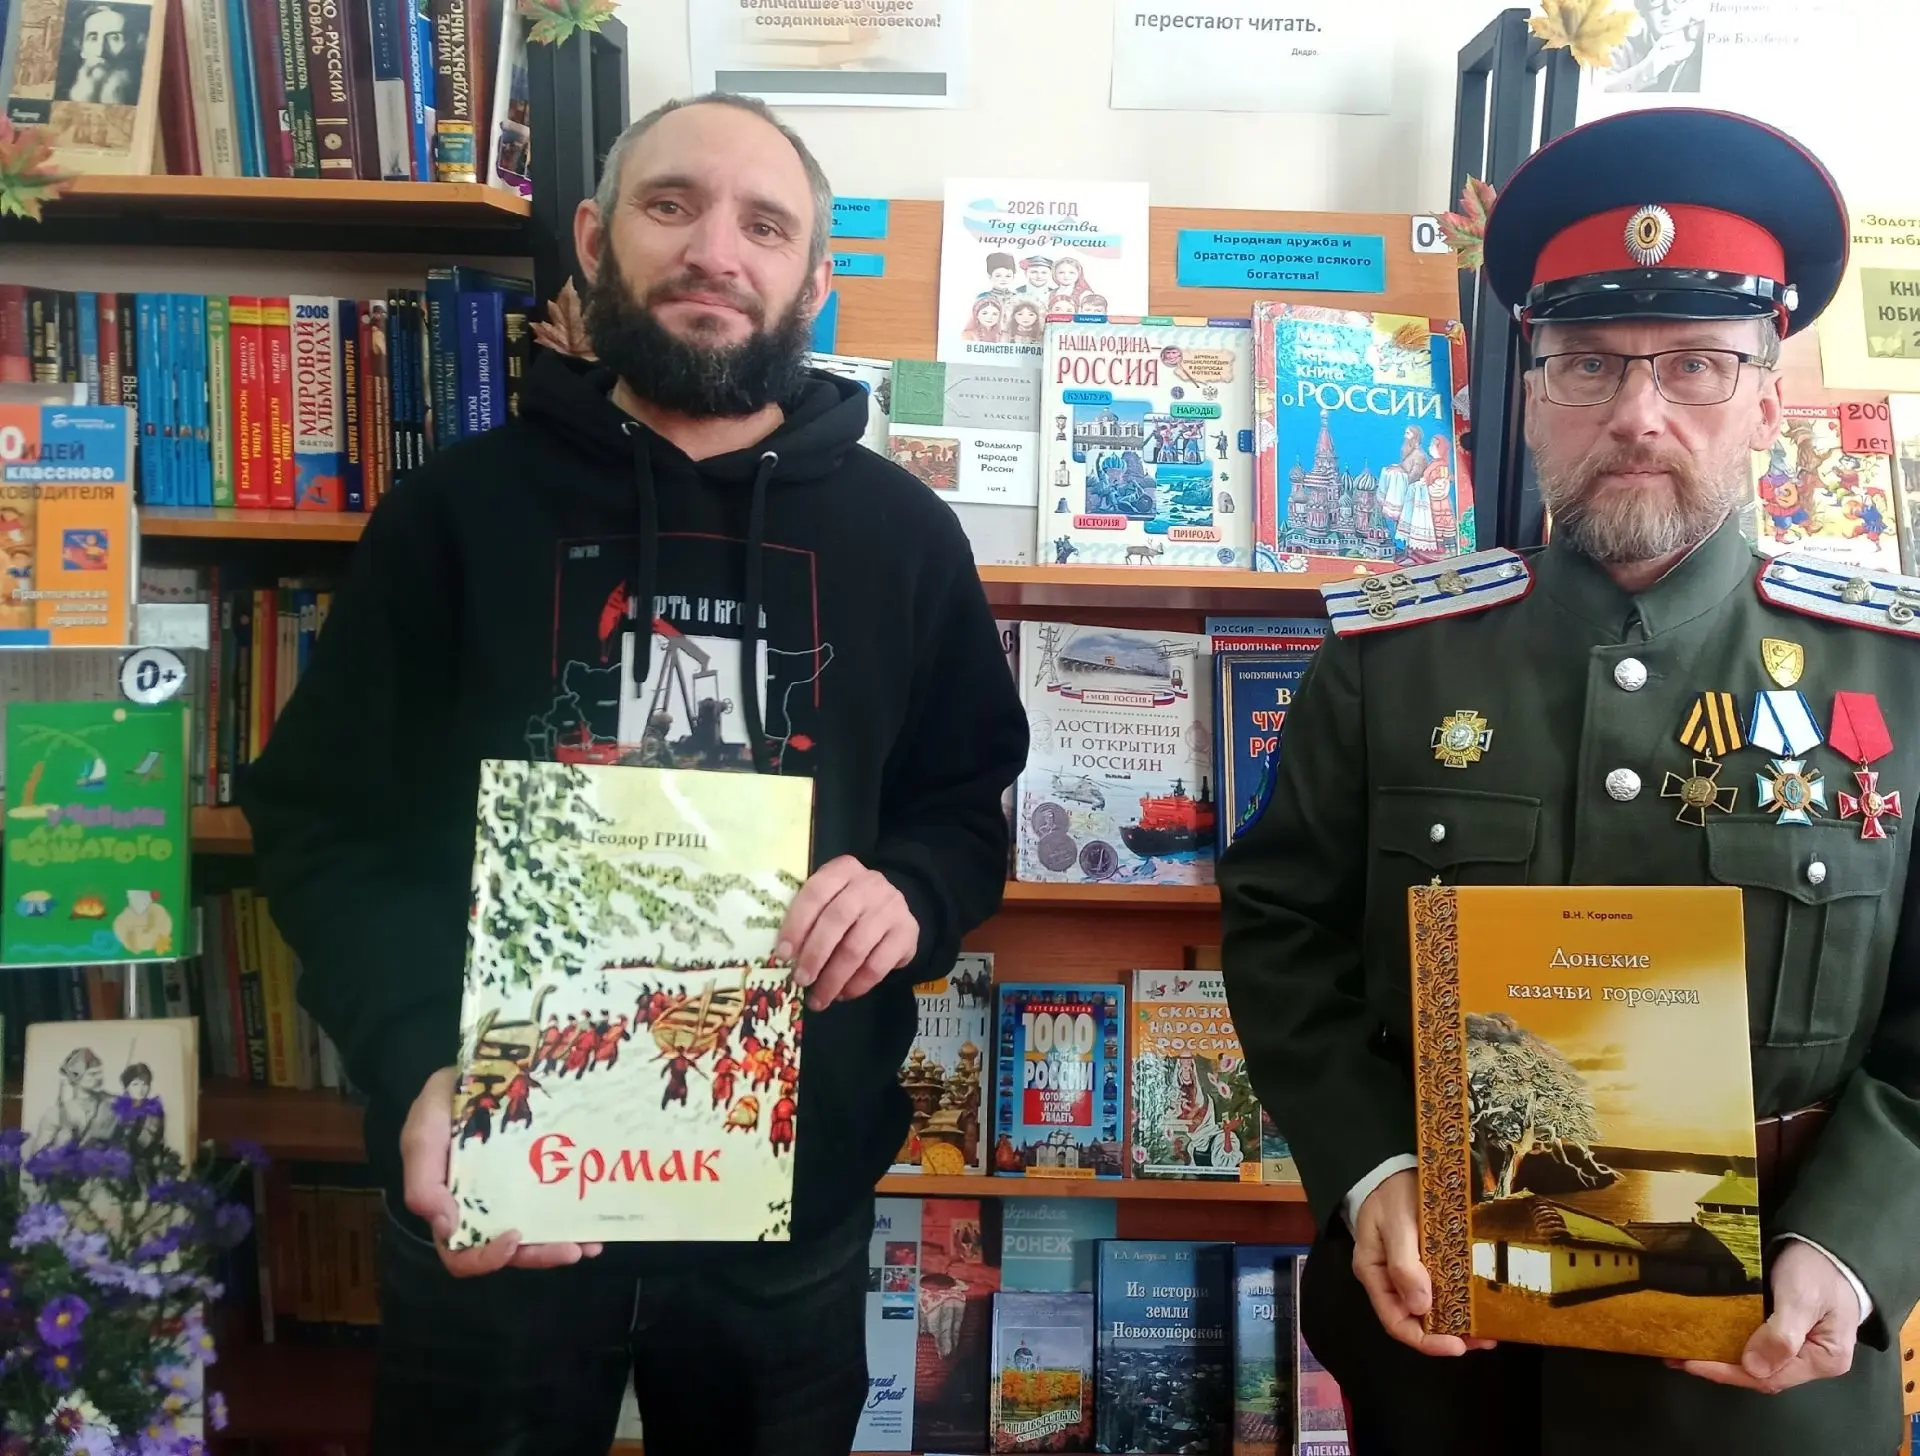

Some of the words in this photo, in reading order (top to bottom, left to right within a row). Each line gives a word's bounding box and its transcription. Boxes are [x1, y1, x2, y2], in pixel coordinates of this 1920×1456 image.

[843, 0, 863, 10] из
[866, 0, 914, 13] чудес
[308, 0, 325, 55] ОВАРЬ
[450, 0, 465, 42] МЫС
[756, 14, 846, 28] созданных
[849, 14, 942, 28] человеком!
[1135, 13, 1243, 31] перестают
[1249, 16, 1322, 32] читать.
[437, 13, 452, 63] МИРЕ
[439, 66, 452, 75] В
[451, 45, 469, 116] МУДРЫХ
[1008, 201, 1044, 216] 2026
[1050, 201, 1078, 216] ГОД
[988, 218, 1016, 233] Год
[1020, 220, 1098, 233] единства
[978, 235, 1050, 249] народов
[1052, 235, 1107, 248] России
[1213, 234, 1282, 246] Народная
[1287, 236, 1338, 249] дружба
[1343, 239, 1352, 248] и
[1194, 251, 1255, 262] братство
[1259, 253, 1313, 264] дороже
[1317, 256, 1371, 267] всякого
[1247, 269, 1320, 280] богатства!
[296, 304, 329, 319] 2008
[1878, 306, 1920, 321] ЮБИ
[966, 345, 973, 353] В
[974, 345, 1014, 354] ЕДИНСТВЕ
[1059, 335, 1097, 351] НАША
[477, 342, 490, 383] ИСТОРИЯ
[294, 321, 315, 436] МИРОВОЙ
[1056, 357, 1158, 386] РОССИЯ
[316, 321, 334, 438] АЛЬМАНАХ
[1067, 391, 1110, 402] КУЛЬТУРА
[1297, 381, 1442, 420] РОССИИ
[468, 396, 478, 432] РОССИИ
[1176, 405, 1214, 416] НАРОДЫ
[1847, 403, 1888, 421] 200
[298, 440, 334, 448] ФАКТОВ
[974, 440, 1023, 452] Фольклор
[1855, 436, 1889, 450] лет
[977, 454, 1018, 463] народов
[6, 466, 115, 481] классного
[981, 464, 1014, 473] России
[1078, 518, 1120, 528] ИСТОРИЯ
[1173, 529, 1215, 540] ПРИРОДА
[697, 597, 709, 622] И
[1214, 625, 1254, 634] РОССИЯ
[1267, 626, 1311, 636] РОДИНА
[136, 660, 177, 692] 0+
[1252, 710, 1286, 731] ЧУ
[1054, 719, 1181, 739] ДОСТИЖЕНИЯ
[1060, 737, 1072, 749] И
[1082, 738, 1176, 755] ОТКРЫТИЯ
[1072, 755, 1163, 772] РОССИЯН
[655, 831, 708, 851] ГРИЦ
[1562, 910, 1584, 919] В.Н.
[1549, 947, 1651, 969] Донские
[1202, 990, 1225, 999] ЧТЕ
[1507, 984, 1592, 1000] казачьи
[1602, 987, 1700, 1008] городки
[1158, 1006, 1231, 1019] СКАЗК
[1021, 1011, 1095, 1054] 1000
[1149, 1021, 1235, 1036] НАРОДО
[1023, 1060, 1094, 1090] РОССИИ
[1043, 1102, 1071, 1112] НУЖНО
[1040, 1112, 1074, 1124] УВИДЕТЬ
[528, 1133, 721, 1201] Ермак
[1004, 1235, 1073, 1253] РОНЕЖ
[1126, 1281, 1146, 1298] Из
[1152, 1286, 1209, 1300] истории
[1146, 1305, 1190, 1318] земли
[1112, 1321, 1223, 1342] Новохопёрской
